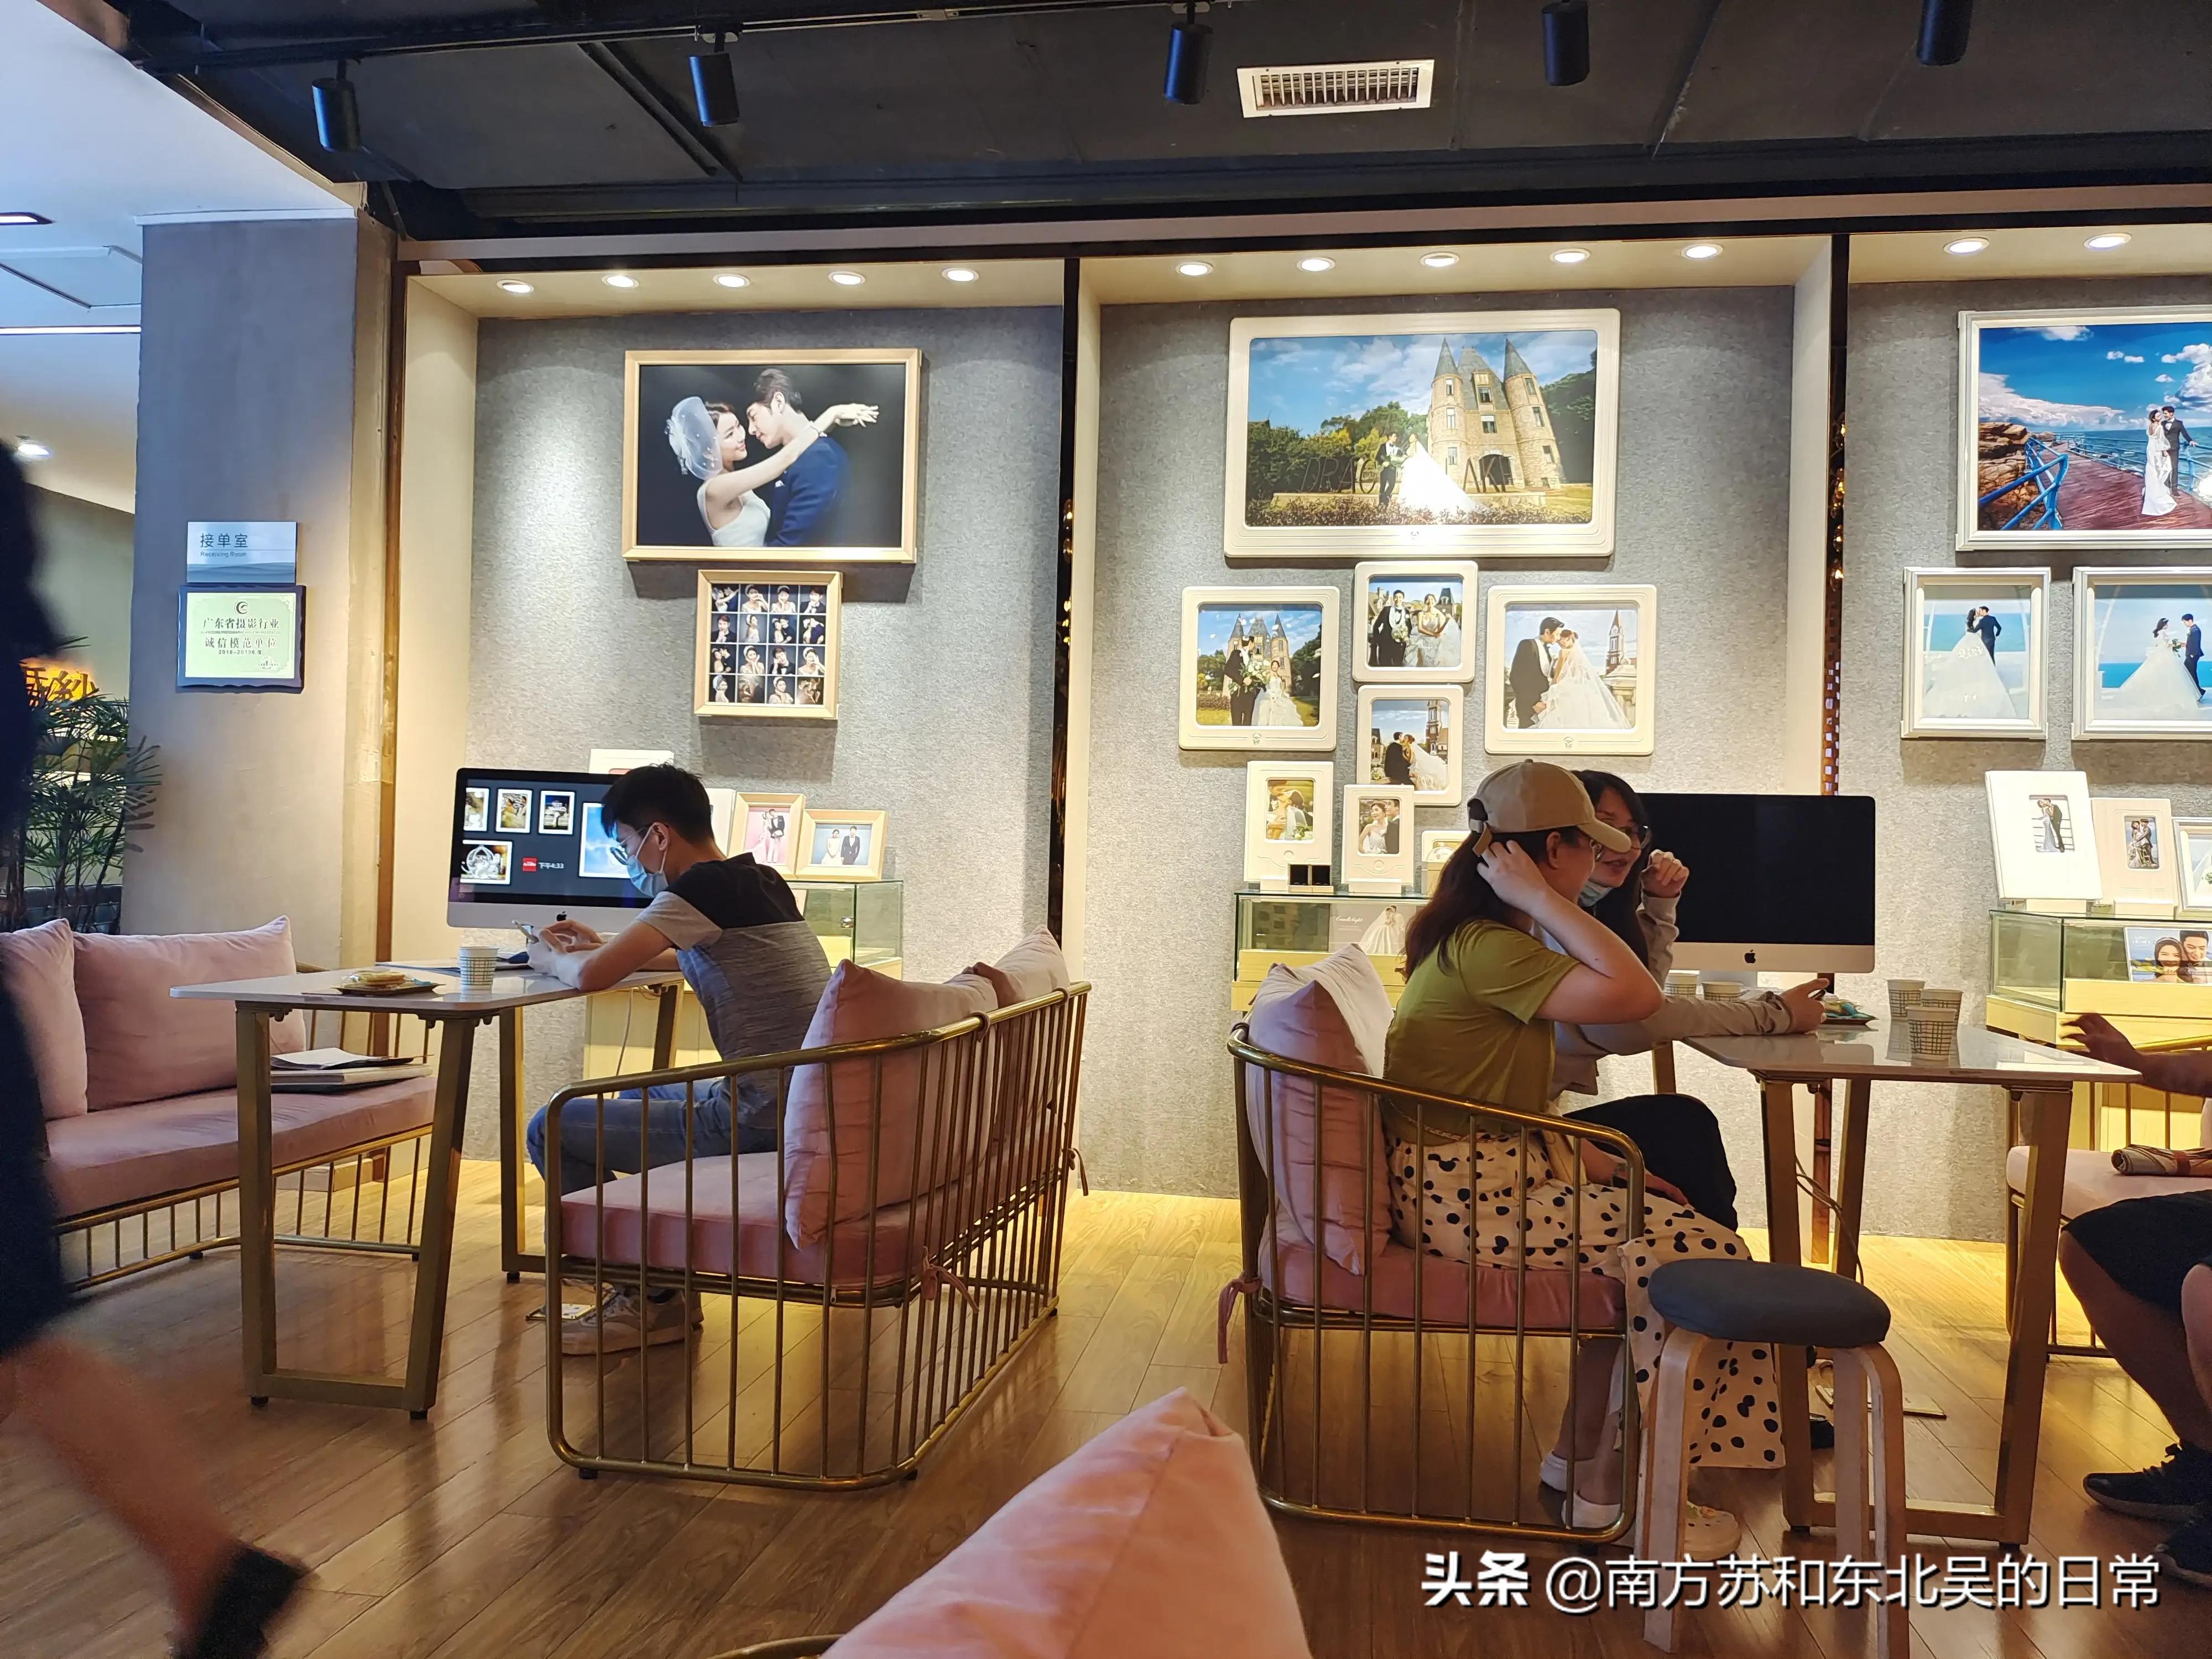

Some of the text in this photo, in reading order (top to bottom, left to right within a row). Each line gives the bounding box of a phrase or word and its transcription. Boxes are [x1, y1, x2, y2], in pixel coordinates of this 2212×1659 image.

[200, 533, 248, 548] 接单室
[203, 617, 279, 629] 广东省摄影行业
[205, 637, 277, 649] 诚信模范单位
